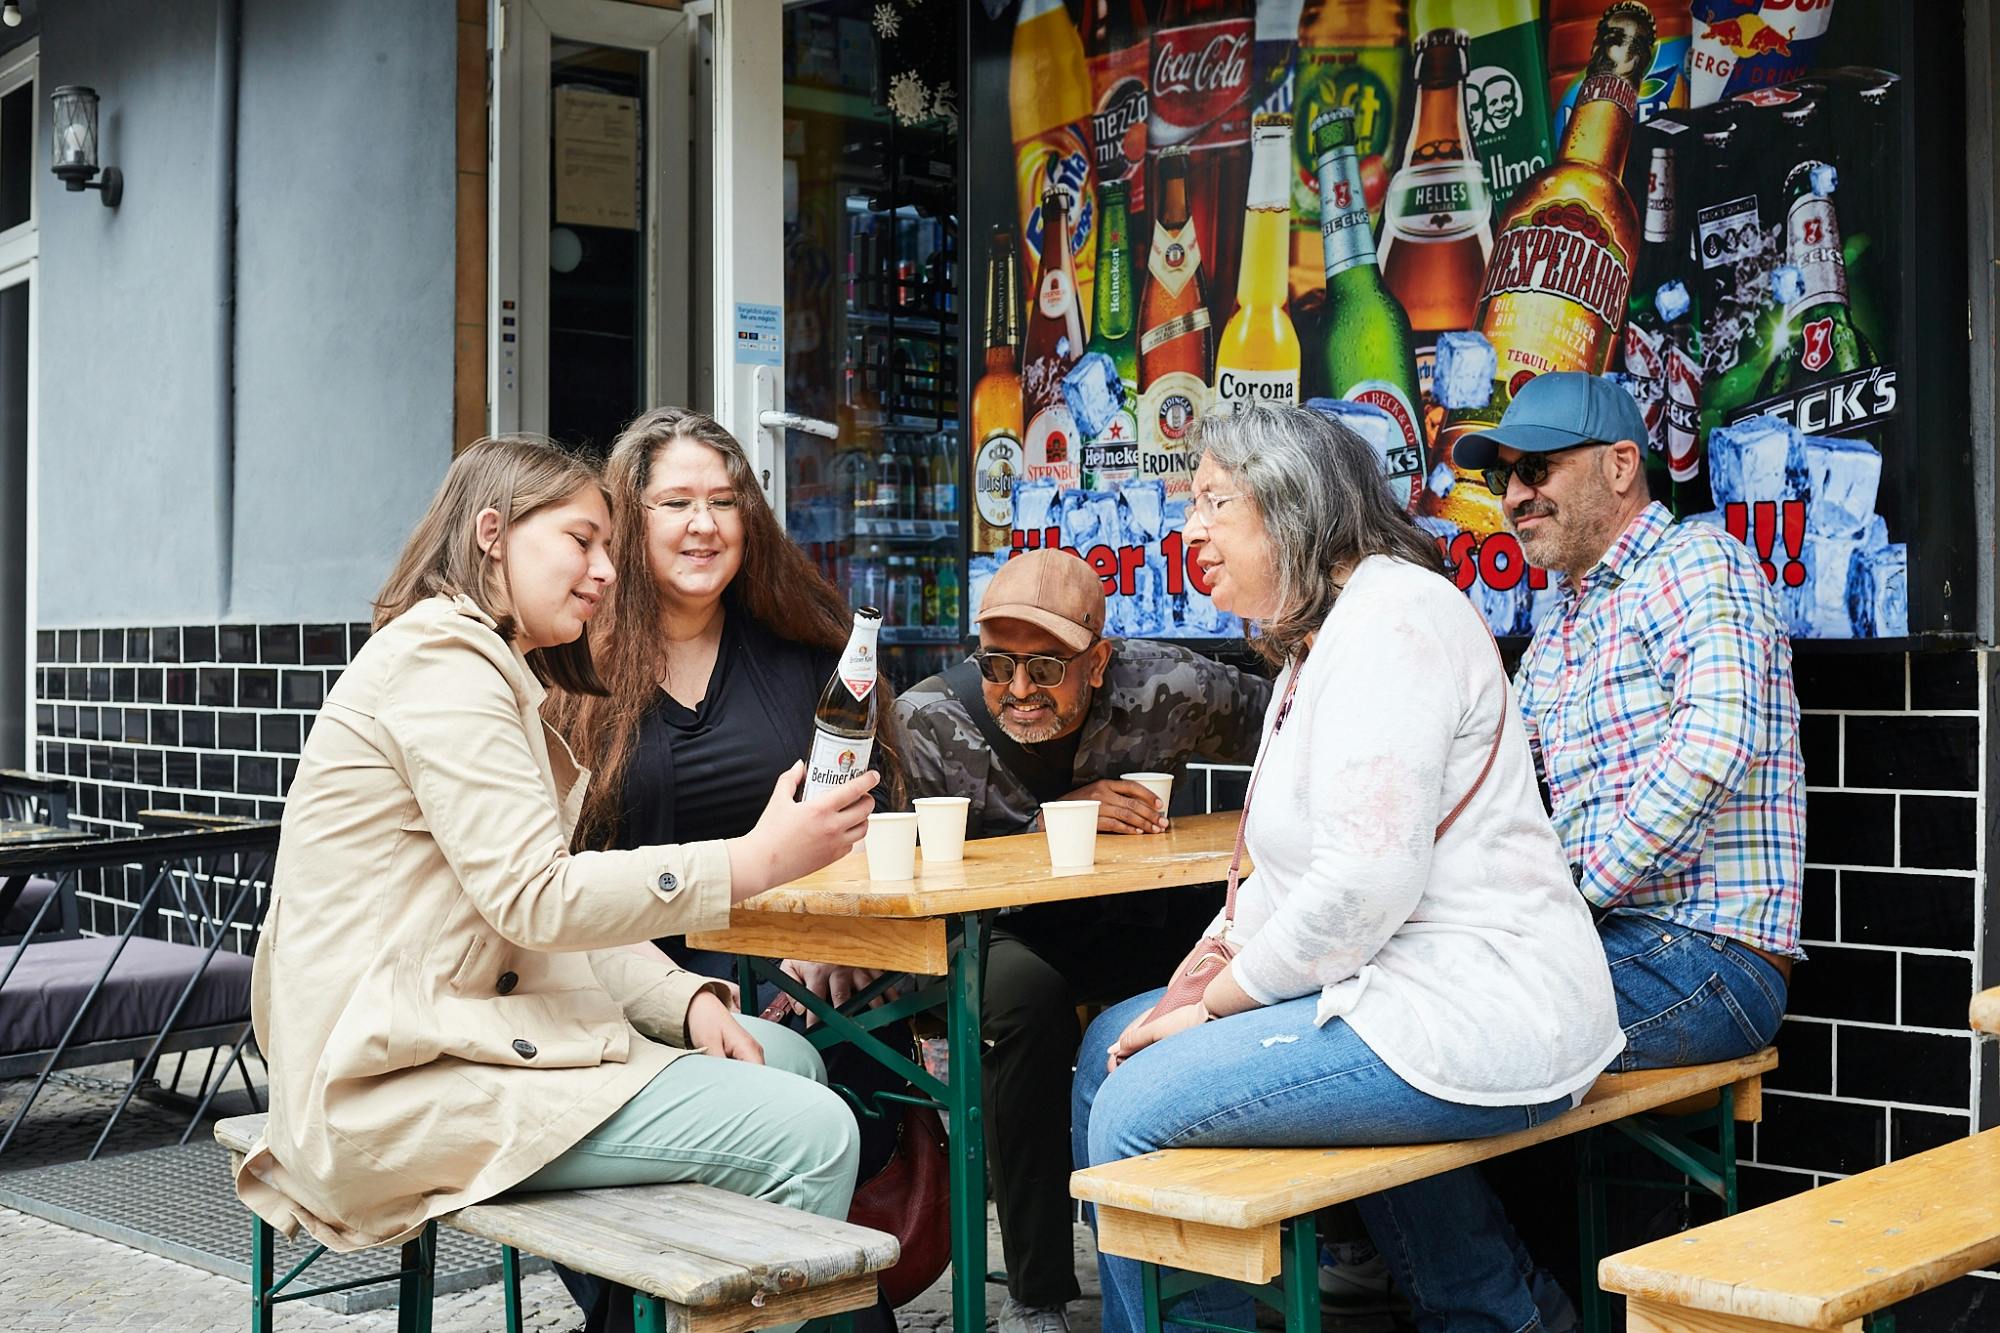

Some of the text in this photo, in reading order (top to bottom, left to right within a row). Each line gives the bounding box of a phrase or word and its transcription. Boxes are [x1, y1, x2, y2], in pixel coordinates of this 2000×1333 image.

[1415, 184, 1467, 206] HELLES
[1321, 211, 1369, 237] BECK'S
[1110, 248, 1120, 313] Heineken
[1486, 228, 1628, 329] DESPERADOS
[1507, 348, 1558, 372] TEQUILA
[1220, 373, 1293, 399] Corona
[1085, 447, 1139, 466] Heineke
[1143, 452, 1200, 476] ERDING
[1387, 449, 1419, 475] K'S
[812, 767, 867, 785] Berliner Kin
